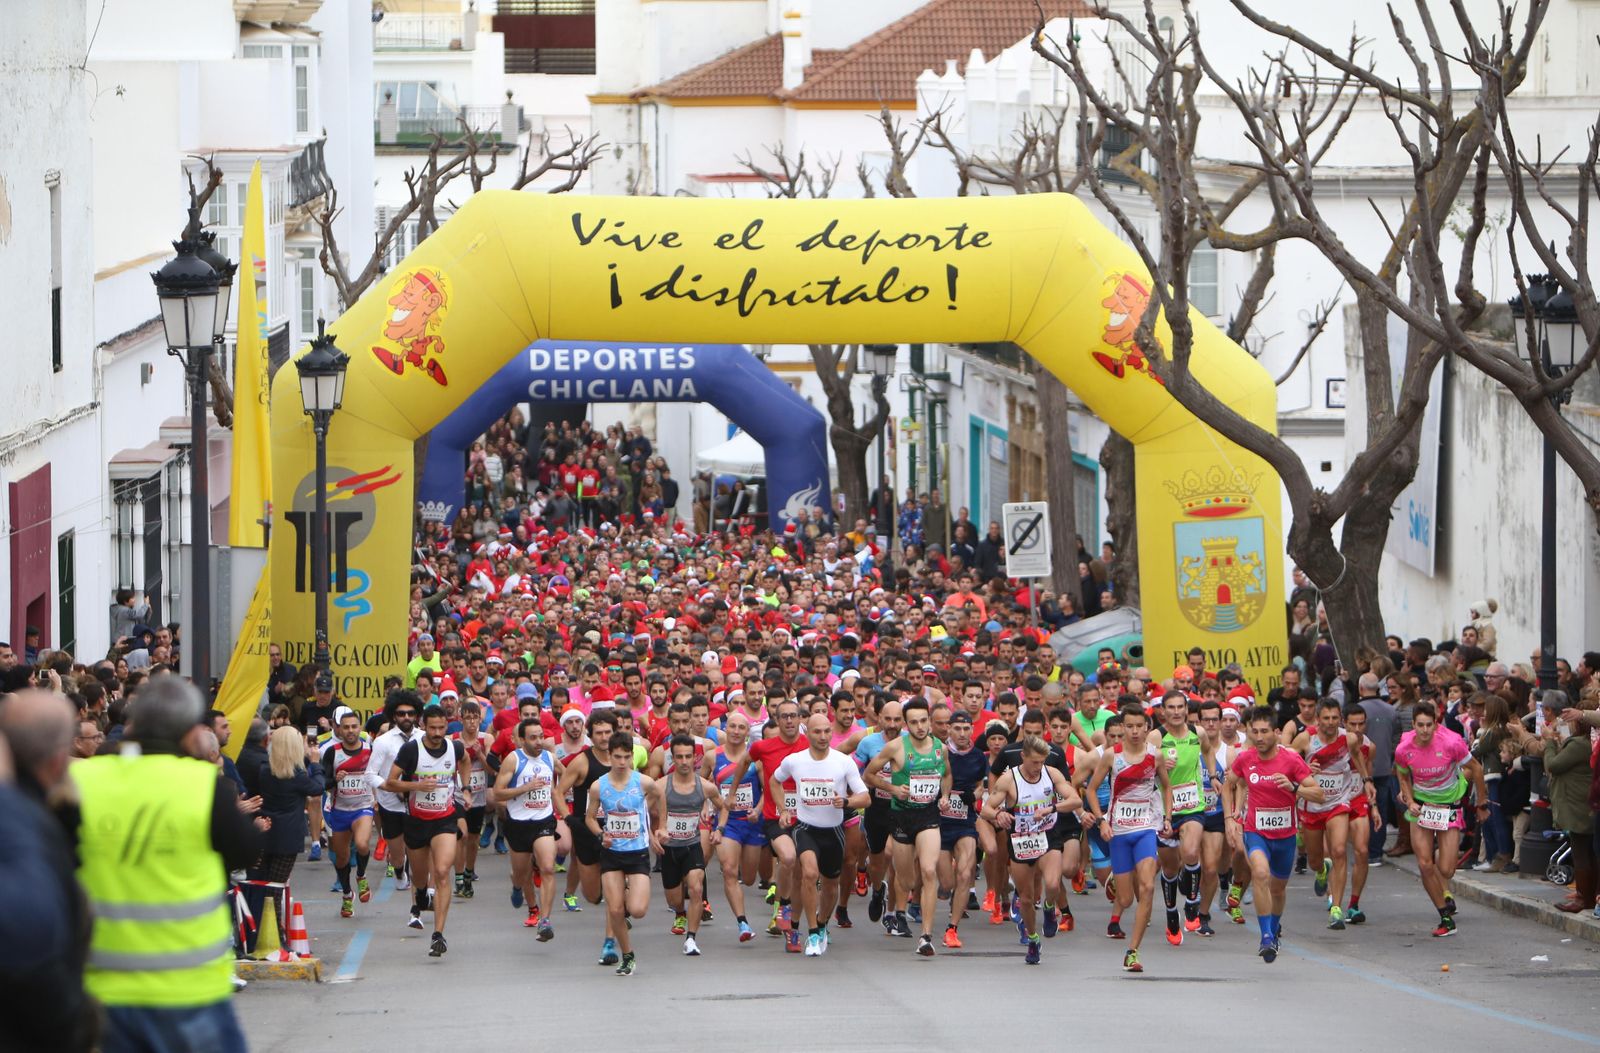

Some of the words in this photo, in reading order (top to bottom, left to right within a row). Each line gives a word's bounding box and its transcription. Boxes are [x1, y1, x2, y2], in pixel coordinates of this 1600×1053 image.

[572, 213, 682, 252] Vive
[713, 219, 764, 251] el
[796, 219, 993, 265] deporte
[529, 347, 696, 371] DEPORTES
[528, 378, 698, 399] CHICLANA
[285, 641, 400, 667] DELGACION
[1244, 645, 1282, 667] AYTO.
[342, 779, 361, 788] 1187
[914, 784, 935, 794] 1472
[1319, 779, 1335, 788] 202
[424, 792, 436, 802] 45
[527, 791, 547, 801] 1375
[804, 787, 828, 798] 1475
[1120, 807, 1142, 818] 1011
[1422, 810, 1442, 821] 1379
[609, 821, 632, 831] 1371
[675, 822, 687, 831] 88
[1259, 816, 1283, 827] 1462
[1016, 838, 1041, 851] 1504
